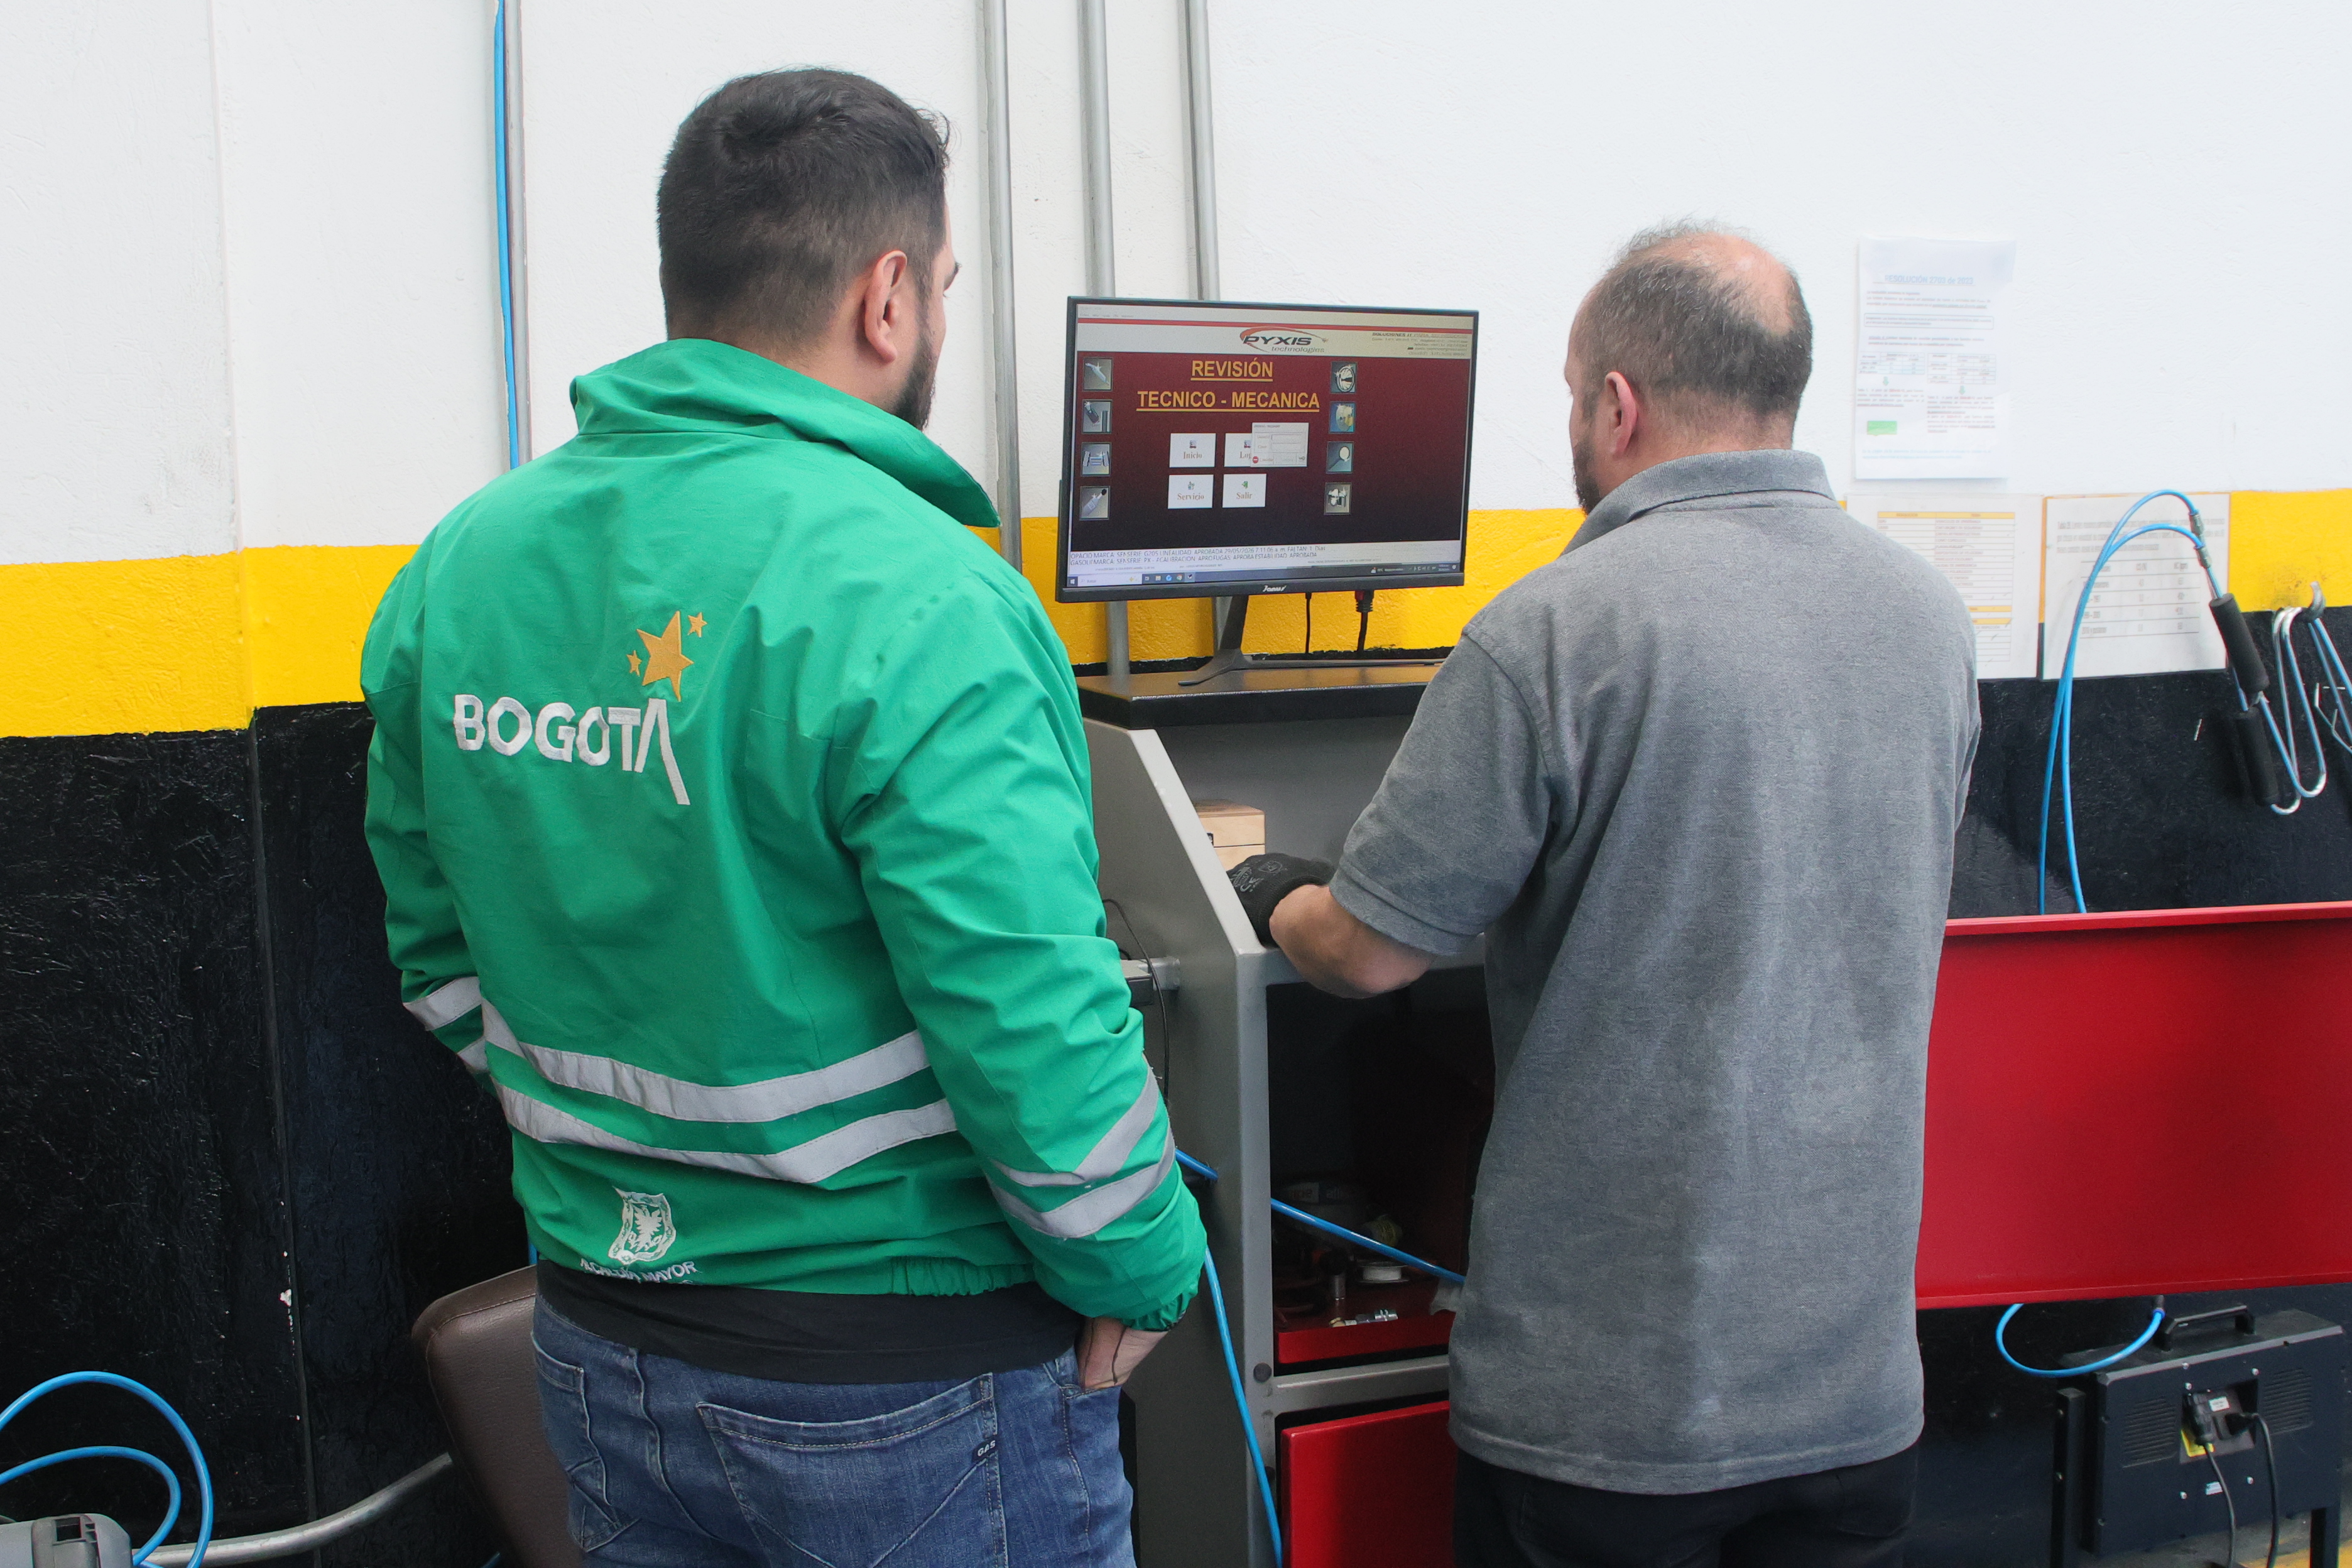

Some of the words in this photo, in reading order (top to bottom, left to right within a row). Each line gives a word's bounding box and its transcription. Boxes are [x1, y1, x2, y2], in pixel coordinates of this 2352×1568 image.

[1947, 276, 1956, 285] de
[1243, 336, 1312, 346] PYXIS
[1191, 357, 1273, 378] REVISIÓN
[1137, 391, 1216, 408] TECNICO
[1231, 391, 1320, 408] MECANICA
[1183, 451, 1202, 459] Inicio
[1177, 493, 1204, 501] Servicio
[641, 1261, 698, 1283] MAYOR
[977, 1440, 996, 1457] GAS
